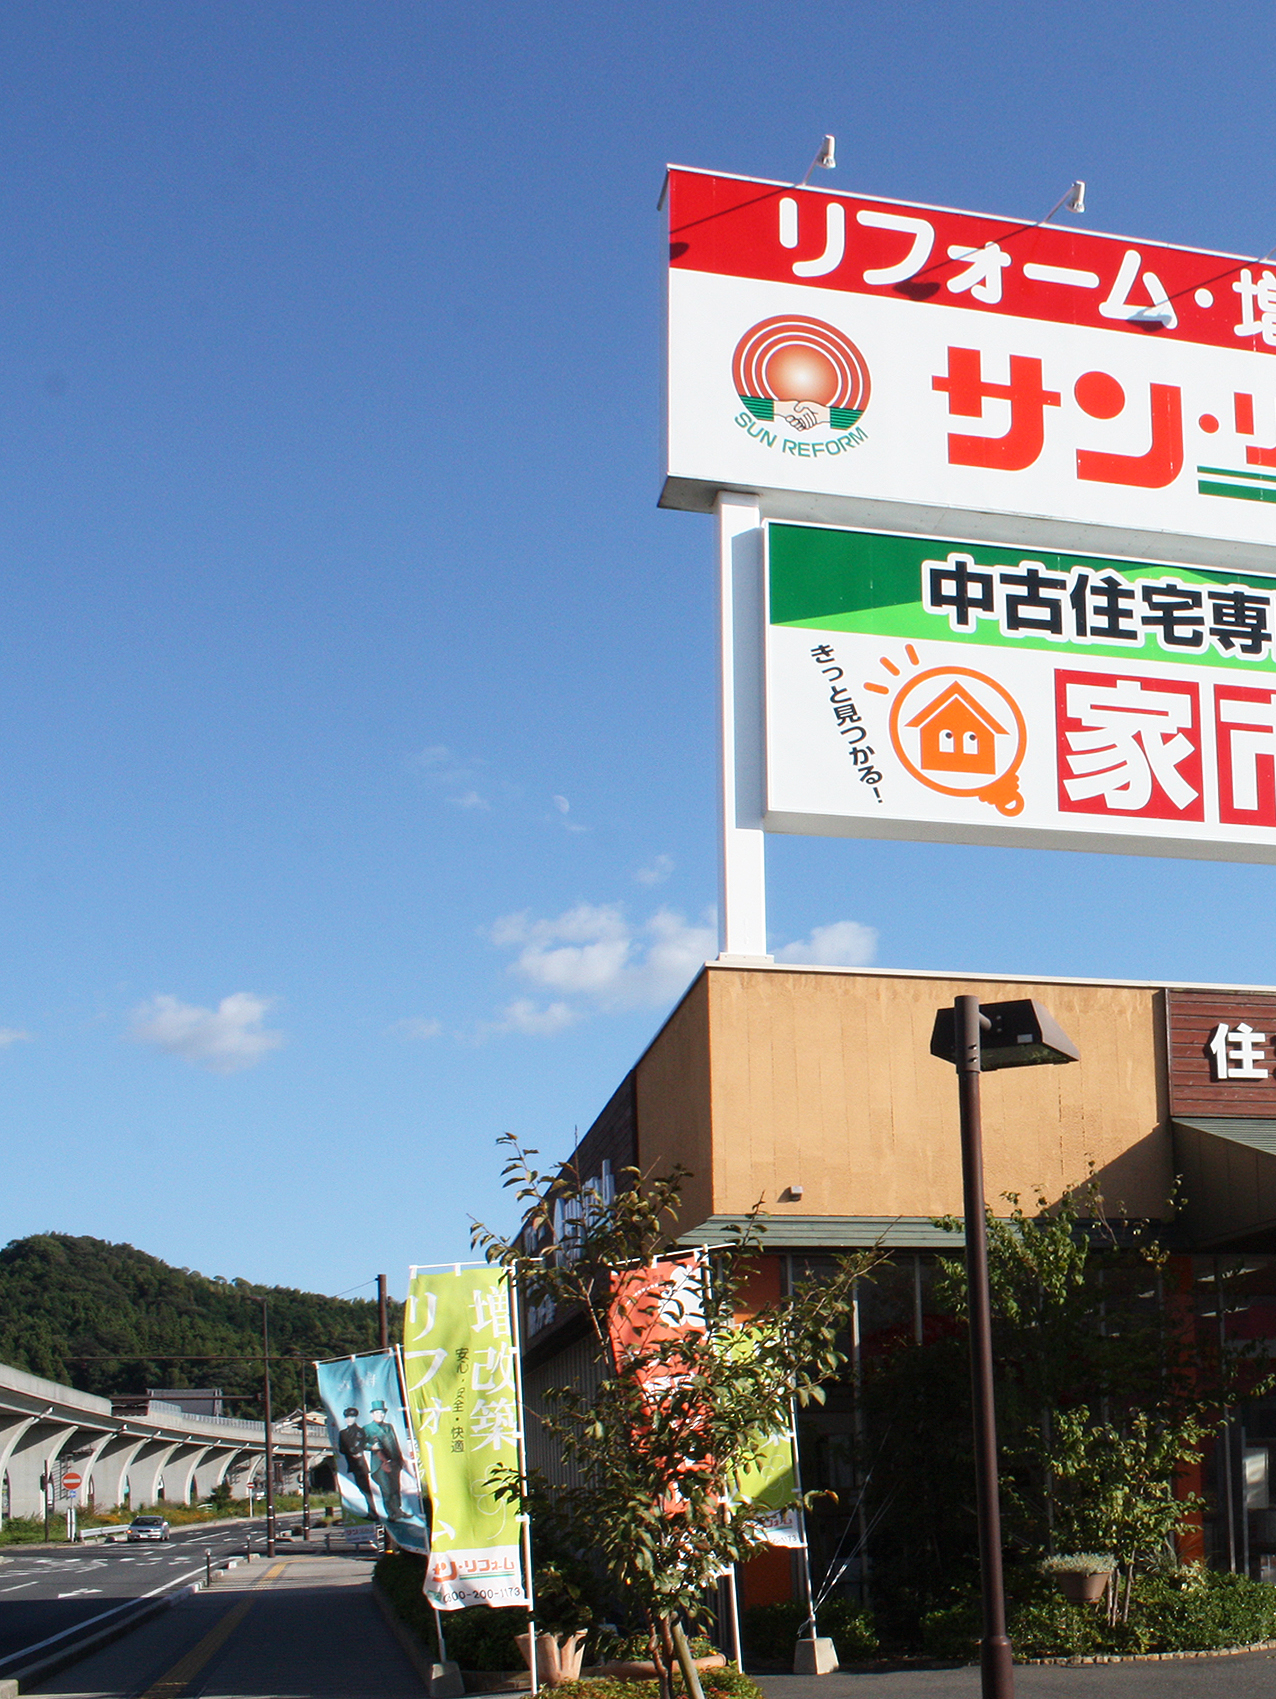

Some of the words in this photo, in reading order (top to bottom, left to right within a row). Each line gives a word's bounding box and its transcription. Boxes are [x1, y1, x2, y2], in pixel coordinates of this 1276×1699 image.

[734, 411, 778, 449] SUN
[782, 426, 869, 458] REFORM
[810, 643, 883, 804] きっと見つかる！
[404, 1291, 456, 1542] リフォーム
[468, 1285, 518, 1453] 増改築
